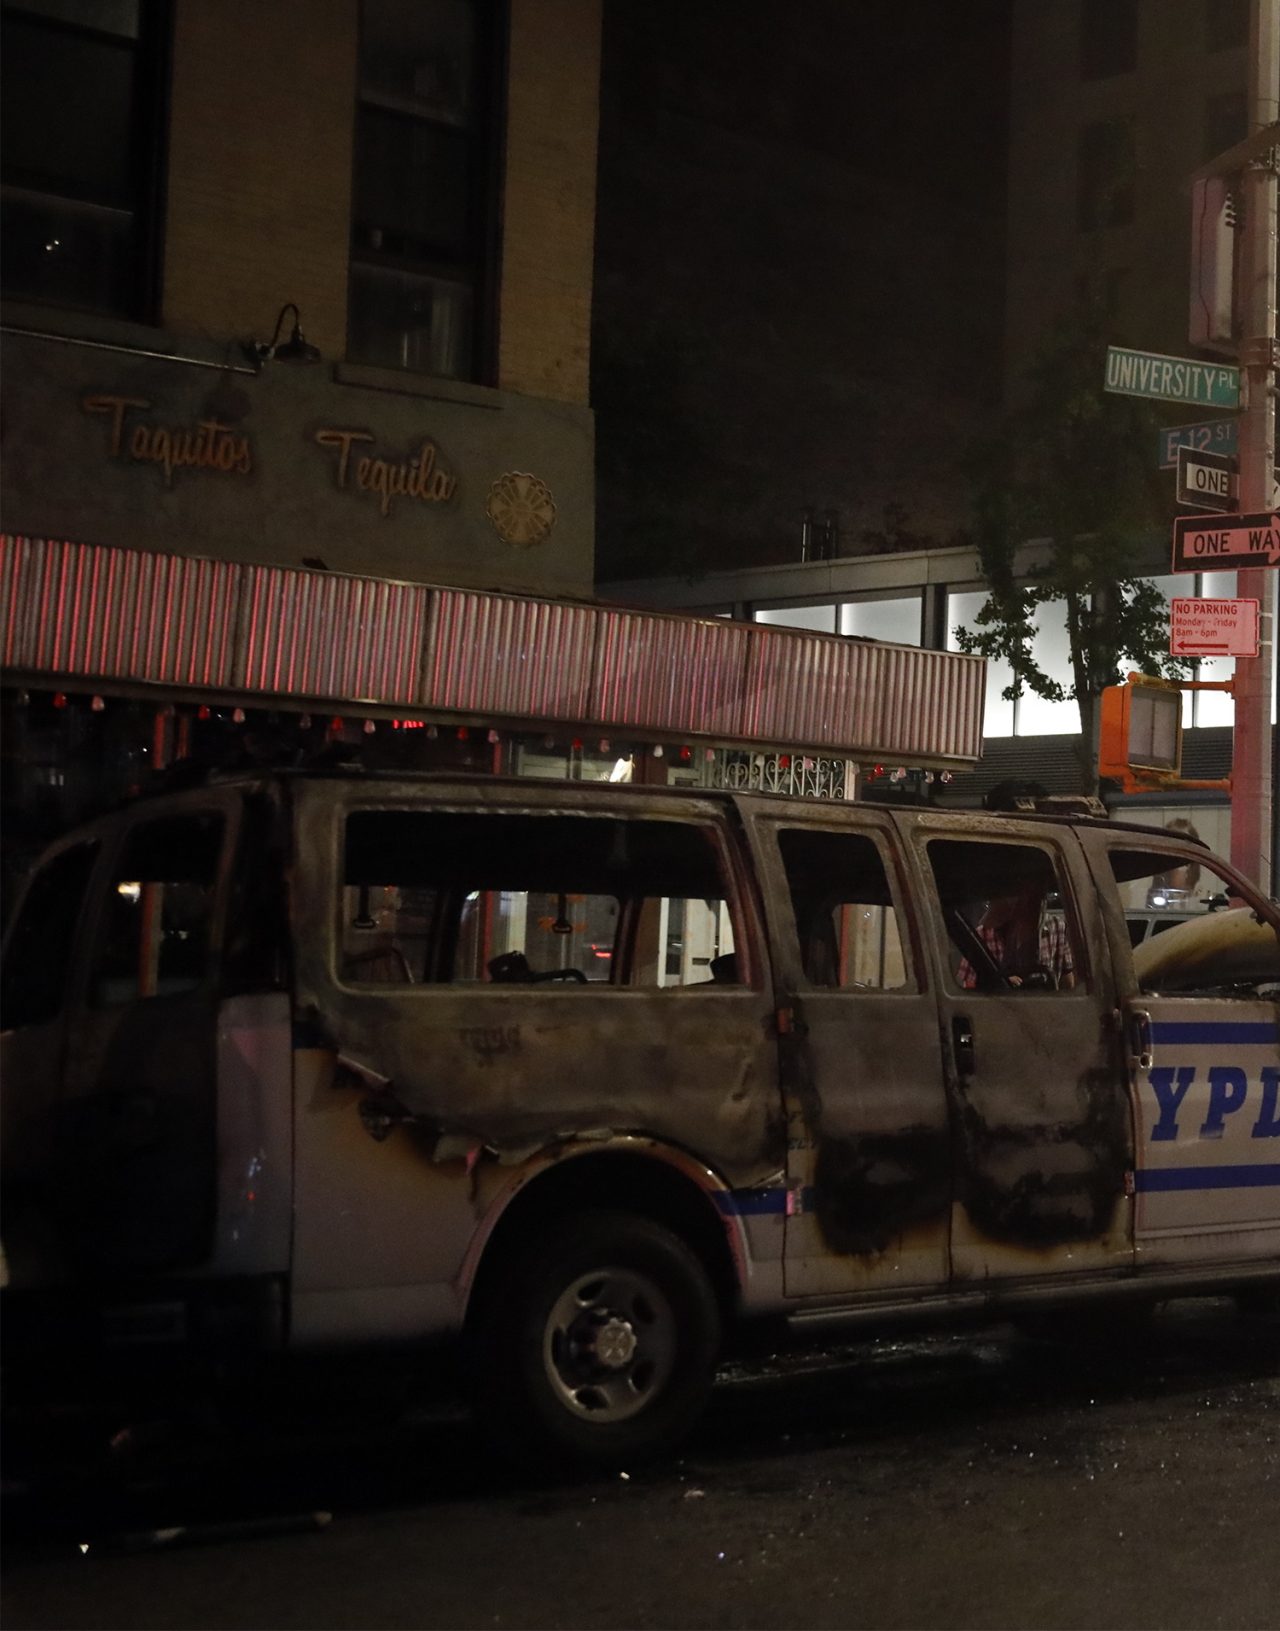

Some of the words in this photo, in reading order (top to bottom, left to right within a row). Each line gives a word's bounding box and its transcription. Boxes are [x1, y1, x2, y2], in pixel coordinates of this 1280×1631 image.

[1106, 353, 1216, 400] UNIVERSITY
[1218, 370, 1237, 390] PL
[84, 394, 252, 487] Taquitos
[316, 429, 457, 517] Tequila
[1167, 431, 1181, 462] E
[1188, 427, 1212, 450] 12
[1216, 423, 1232, 440] ST
[1195, 468, 1229, 494] ONE
[1193, 532, 1231, 555] ONE
[1175, 603, 1190, 615] NO
[1193, 604, 1238, 616] PARKING
[1175, 628, 1193, 637] 8am
